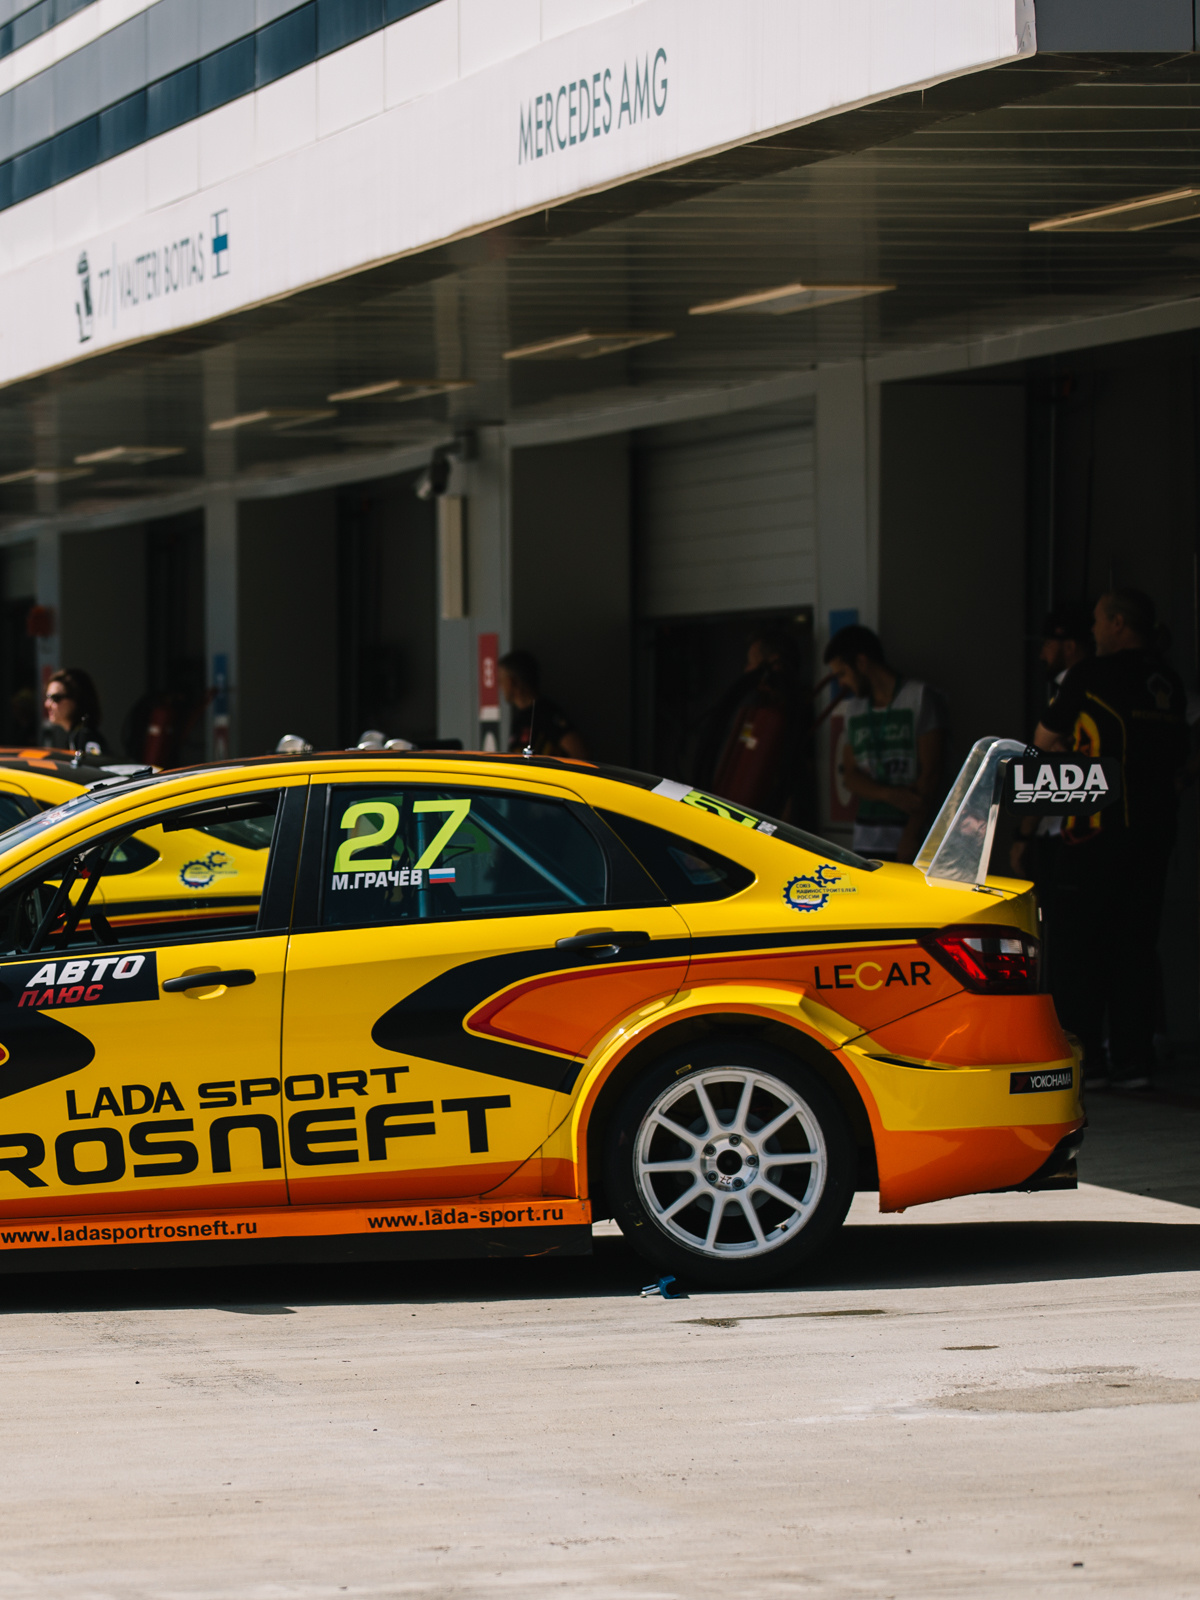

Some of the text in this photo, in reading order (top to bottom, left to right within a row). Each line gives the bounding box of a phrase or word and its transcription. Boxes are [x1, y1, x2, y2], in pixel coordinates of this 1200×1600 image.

[518, 47, 668, 166] MERCEDES AMG
[1013, 764, 1109, 791] LADA
[1013, 790, 1106, 803] SPORT
[333, 798, 471, 873] 27
[331, 866, 423, 890] М.ГРАЧЁВ
[25, 955, 145, 987] АВТО
[814, 961, 932, 991] LECAR
[17, 984, 104, 1008] ПЛЮС
[66, 1066, 410, 1120] LADA SPORT
[1030, 1074, 1072, 1089] YOKOHAMA
[368, 1206, 564, 1229] www.lada-sport.ru
[1, 1219, 258, 1243] www.ladasportrosneft.ru
